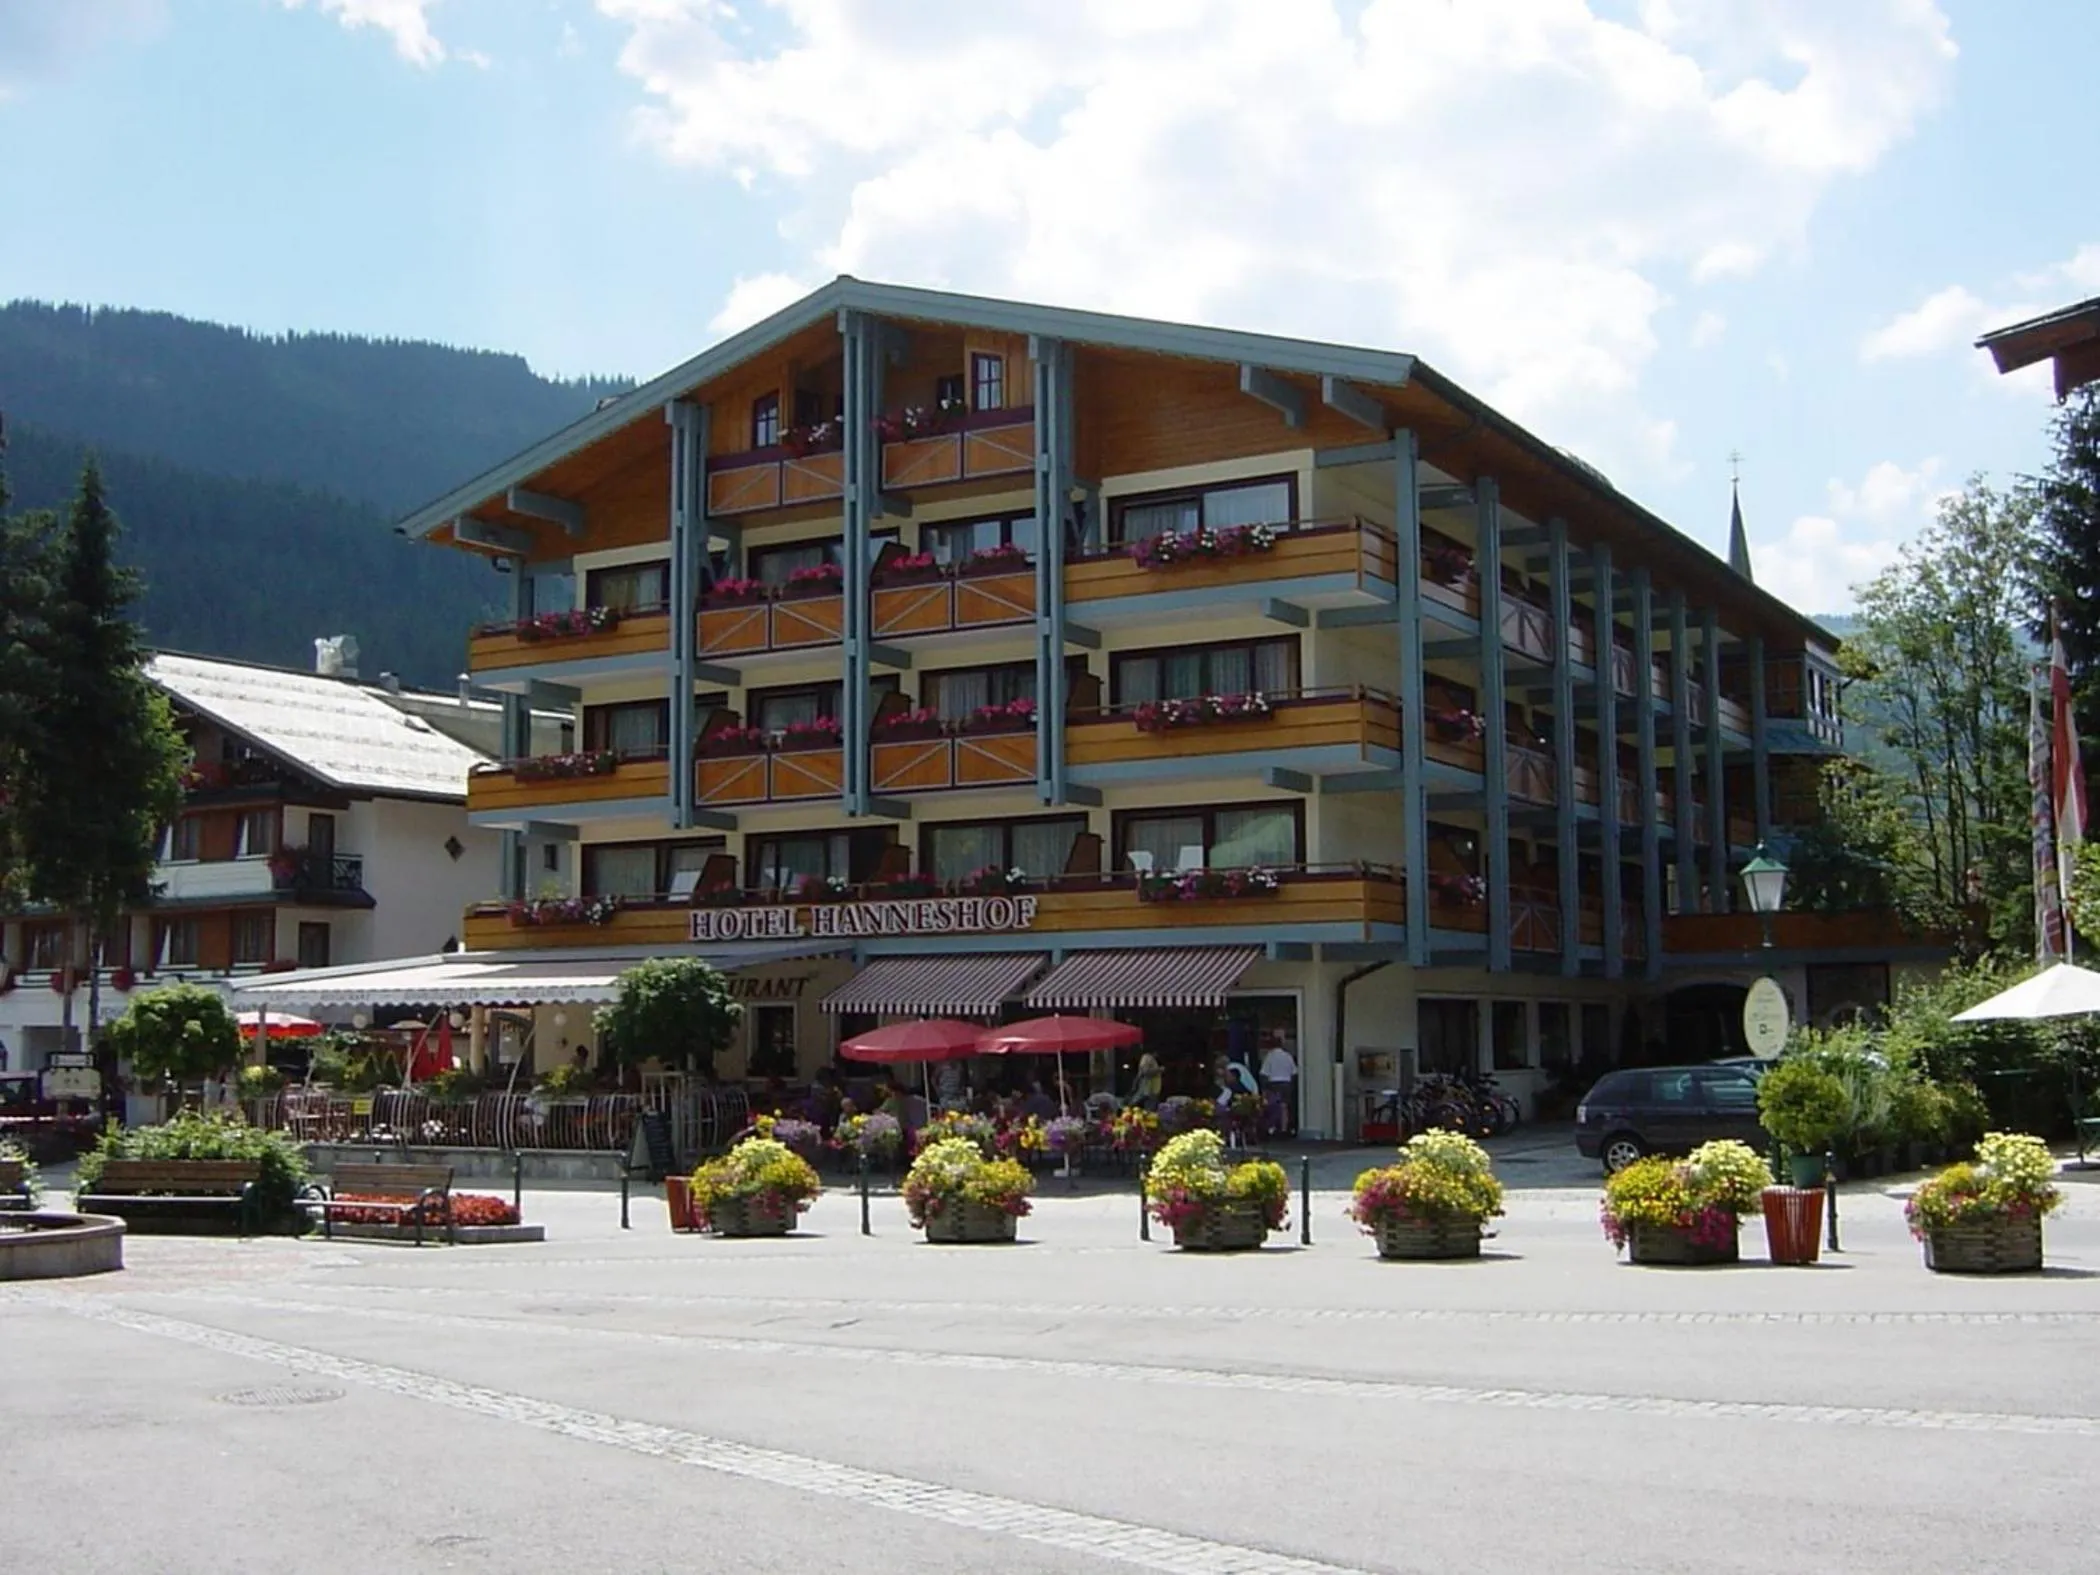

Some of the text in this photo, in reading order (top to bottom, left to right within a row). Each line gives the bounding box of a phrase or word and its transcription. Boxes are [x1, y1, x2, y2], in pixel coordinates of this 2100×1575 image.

[690, 896, 1036, 940] HOTEL HANNESHOF
[728, 977, 810, 998] URANT
